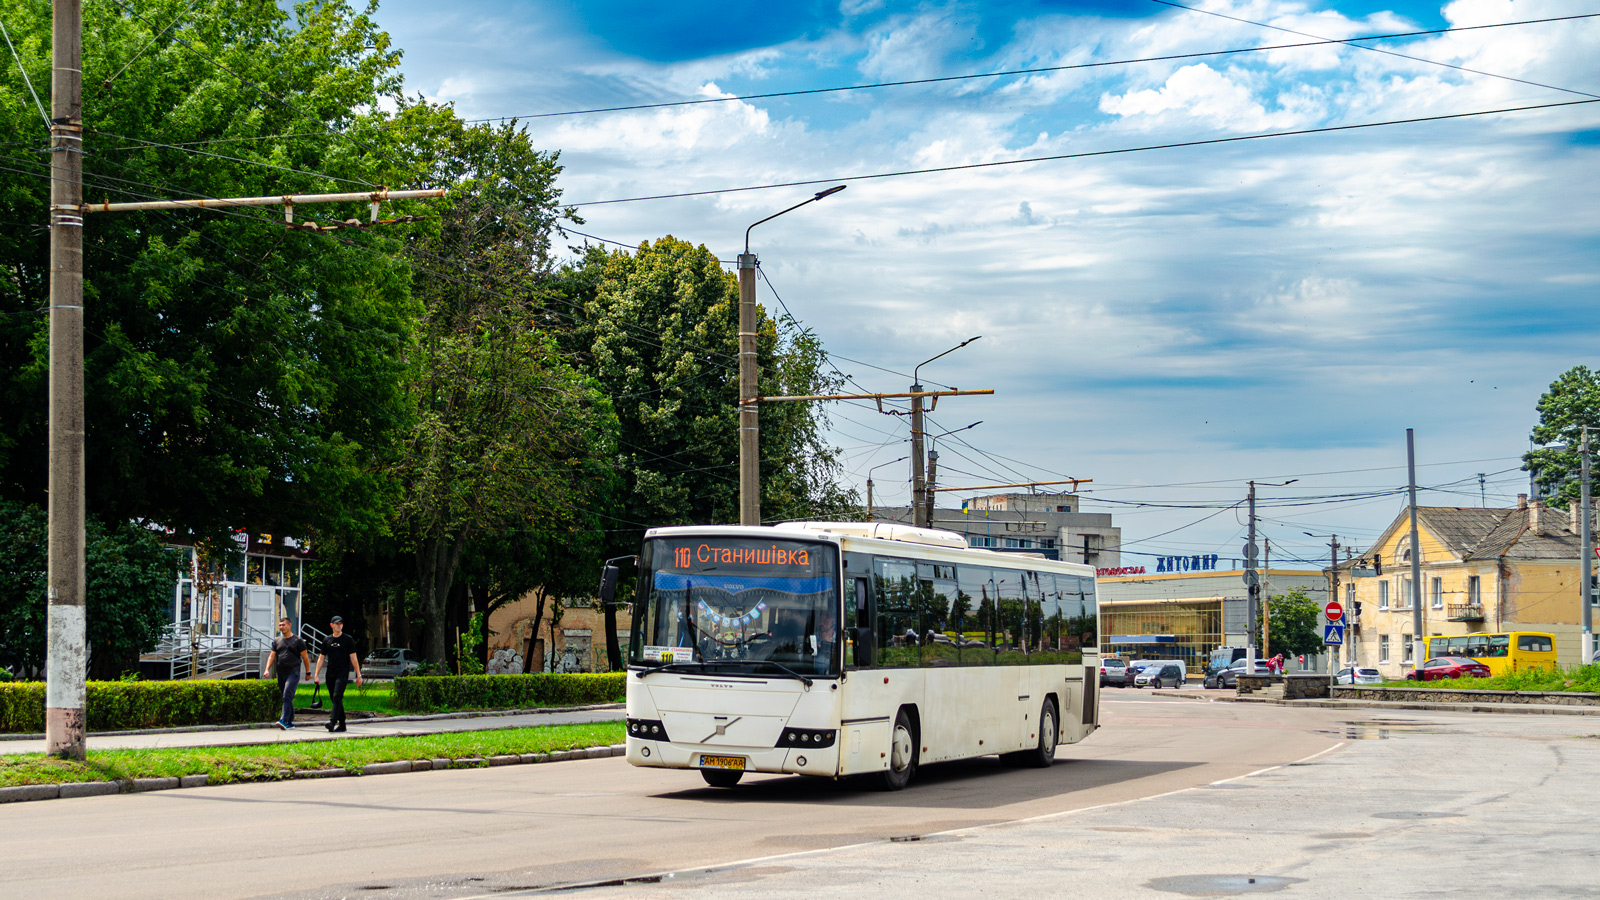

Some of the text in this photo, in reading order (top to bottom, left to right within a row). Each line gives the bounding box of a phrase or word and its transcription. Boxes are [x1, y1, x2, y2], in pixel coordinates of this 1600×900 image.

[674, 544, 810, 568] 110 Станишівка
[1156, 554, 1218, 572] ЖИТОМИР
[1096, 566, 1146, 576] ВТОВОКЗАЛ
[661, 653, 673, 664] 110
[704, 756, 715, 765] AM
